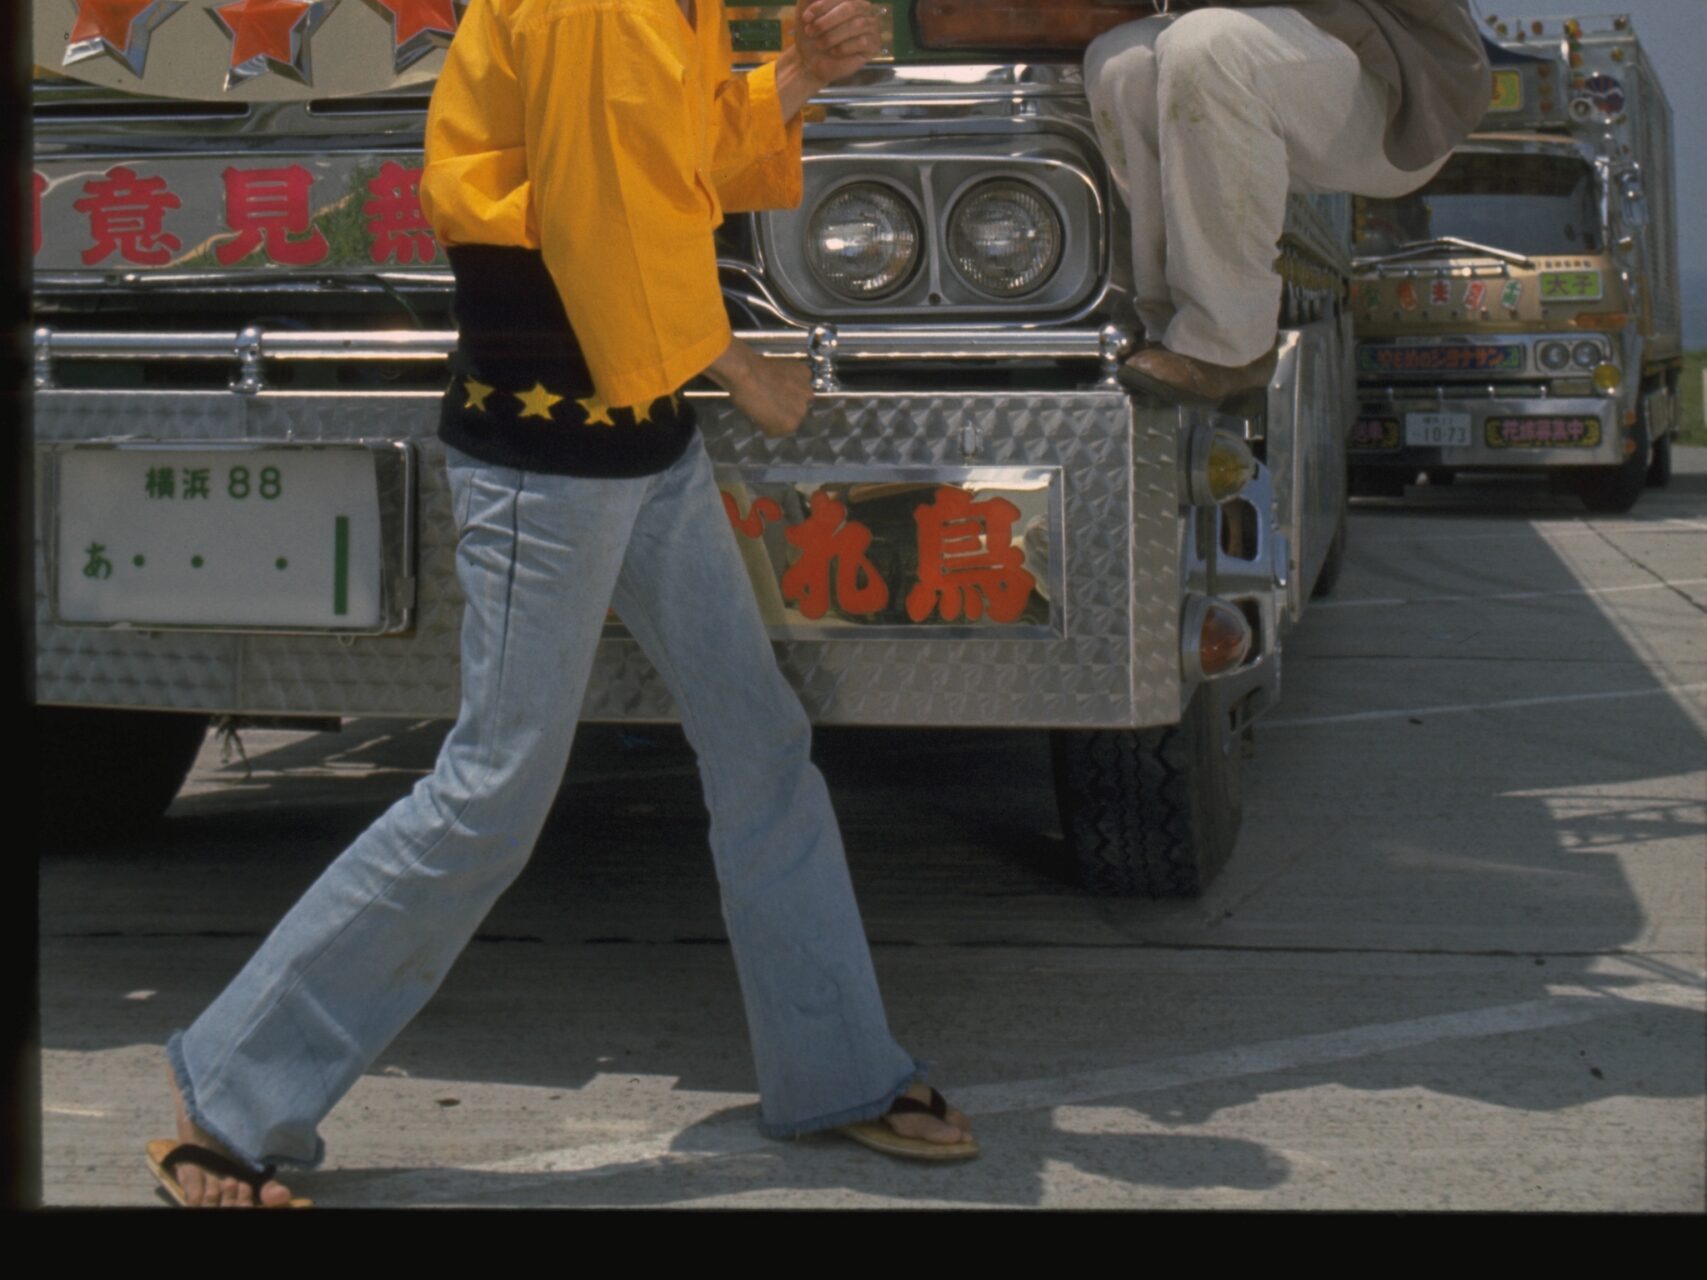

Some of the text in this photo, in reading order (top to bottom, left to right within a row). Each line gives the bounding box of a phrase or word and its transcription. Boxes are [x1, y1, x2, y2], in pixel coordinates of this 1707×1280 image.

[34, 160, 447, 266] 意見無
[145, 465, 282, 500] 横浜 88
